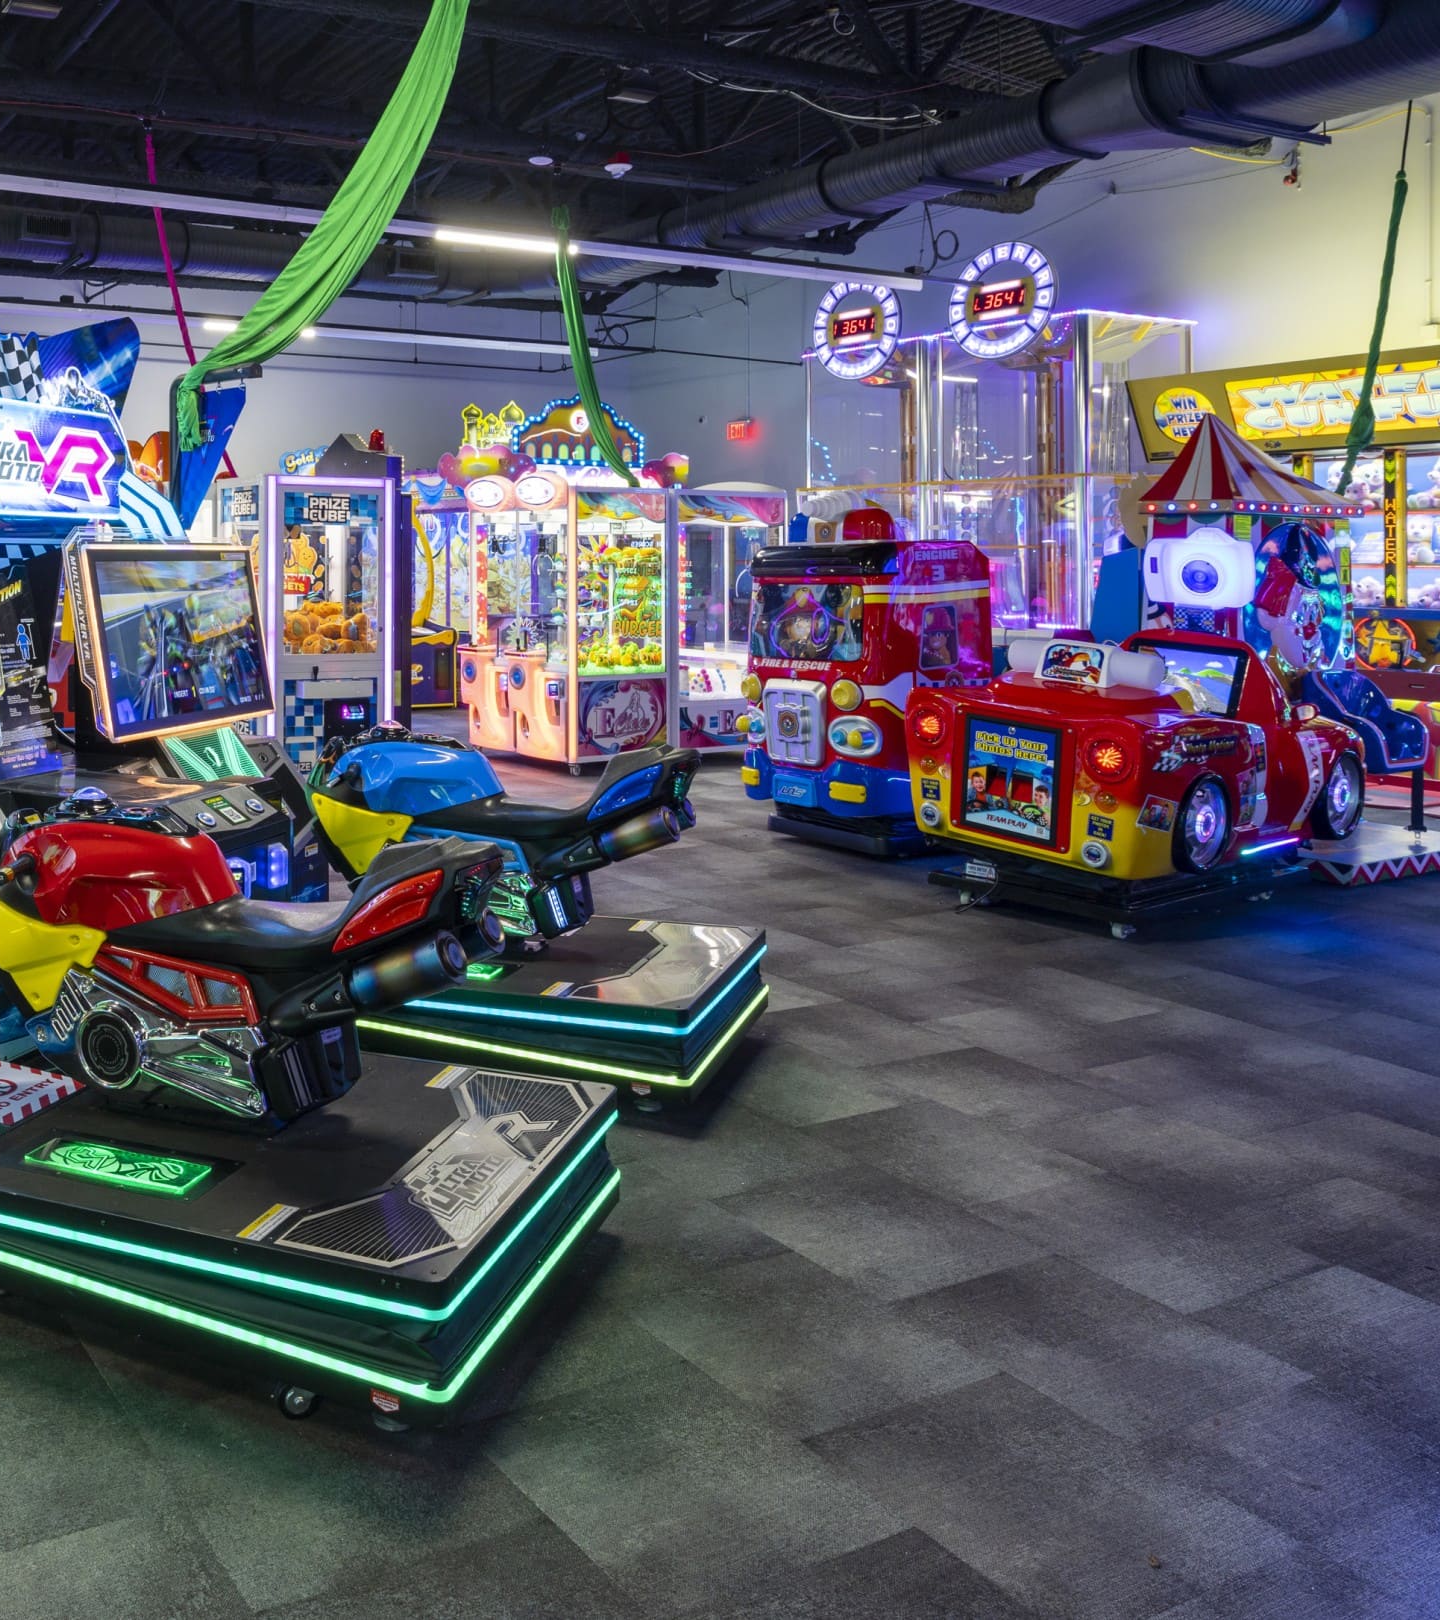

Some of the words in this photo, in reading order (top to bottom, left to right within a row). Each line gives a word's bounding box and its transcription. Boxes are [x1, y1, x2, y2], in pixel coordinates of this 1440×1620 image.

[1170, 396, 1198, 410] WIN
[730, 423, 745, 439] EXIT
[1172, 426, 1198, 437] HER
[13, 428, 111, 497] VR
[285, 451, 315, 474] Gold
[233, 491, 253, 503] PRIZE
[309, 497, 350, 510] PRIZE
[233, 503, 252, 516] CUBE
[309, 510, 347, 522] CUBE
[1384, 498, 1397, 564] WATER
[914, 549, 959, 562] ENGINE
[931, 564, 946, 582] 3
[68, 555, 89, 639] MULTIPLAYER
[80, 642, 91, 660] VR
[761, 658, 782, 668] FIRE
[782, 659, 790, 669] &
[791, 660, 832, 672] RESCUE
[593, 707, 615, 739] E
[974, 741, 1013, 757] Photos
[975, 731, 1001, 746] Pick
[1019, 738, 1048, 753] Your
[986, 813, 1008, 826] TEAM
[1007, 818, 1028, 831] PLAY
[10, 1077, 56, 1104] ENTRY
[426, 1156, 483, 1213] ULTRA
[453, 1153, 507, 1201] MOTO
